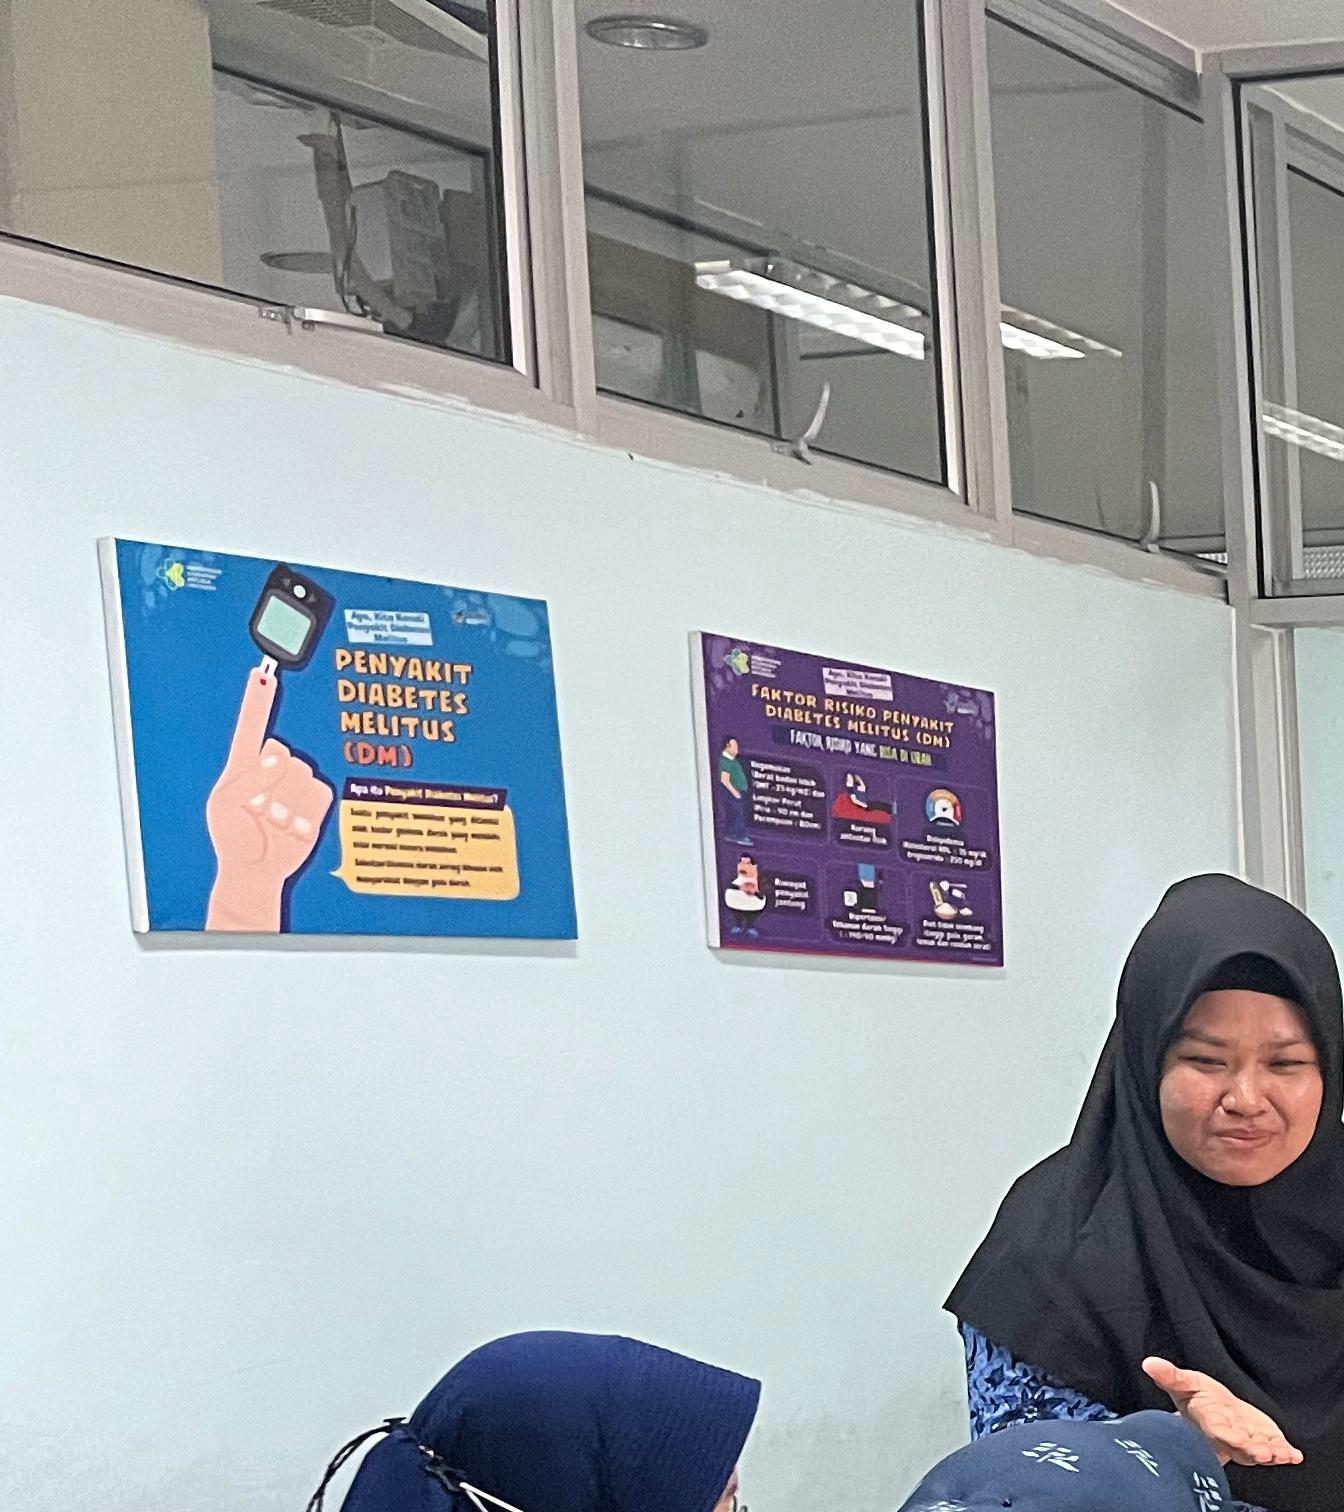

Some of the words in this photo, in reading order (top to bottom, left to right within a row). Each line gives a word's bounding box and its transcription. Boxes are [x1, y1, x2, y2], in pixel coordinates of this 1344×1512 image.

[335, 648, 473, 685] PENYAKIT
[337, 678, 468, 714] DIABETES
[751, 683, 817, 708] FAKTOR
[824, 698, 877, 719] RISIKO
[883, 709, 954, 734] PENYAKIT
[340, 710, 456, 743] MELITUS
[765, 704, 840, 729] DIABETES
[847, 719, 910, 743] MELITUS
[916, 731, 951, 748] (DM)
[343, 740, 413, 768] (DM)
